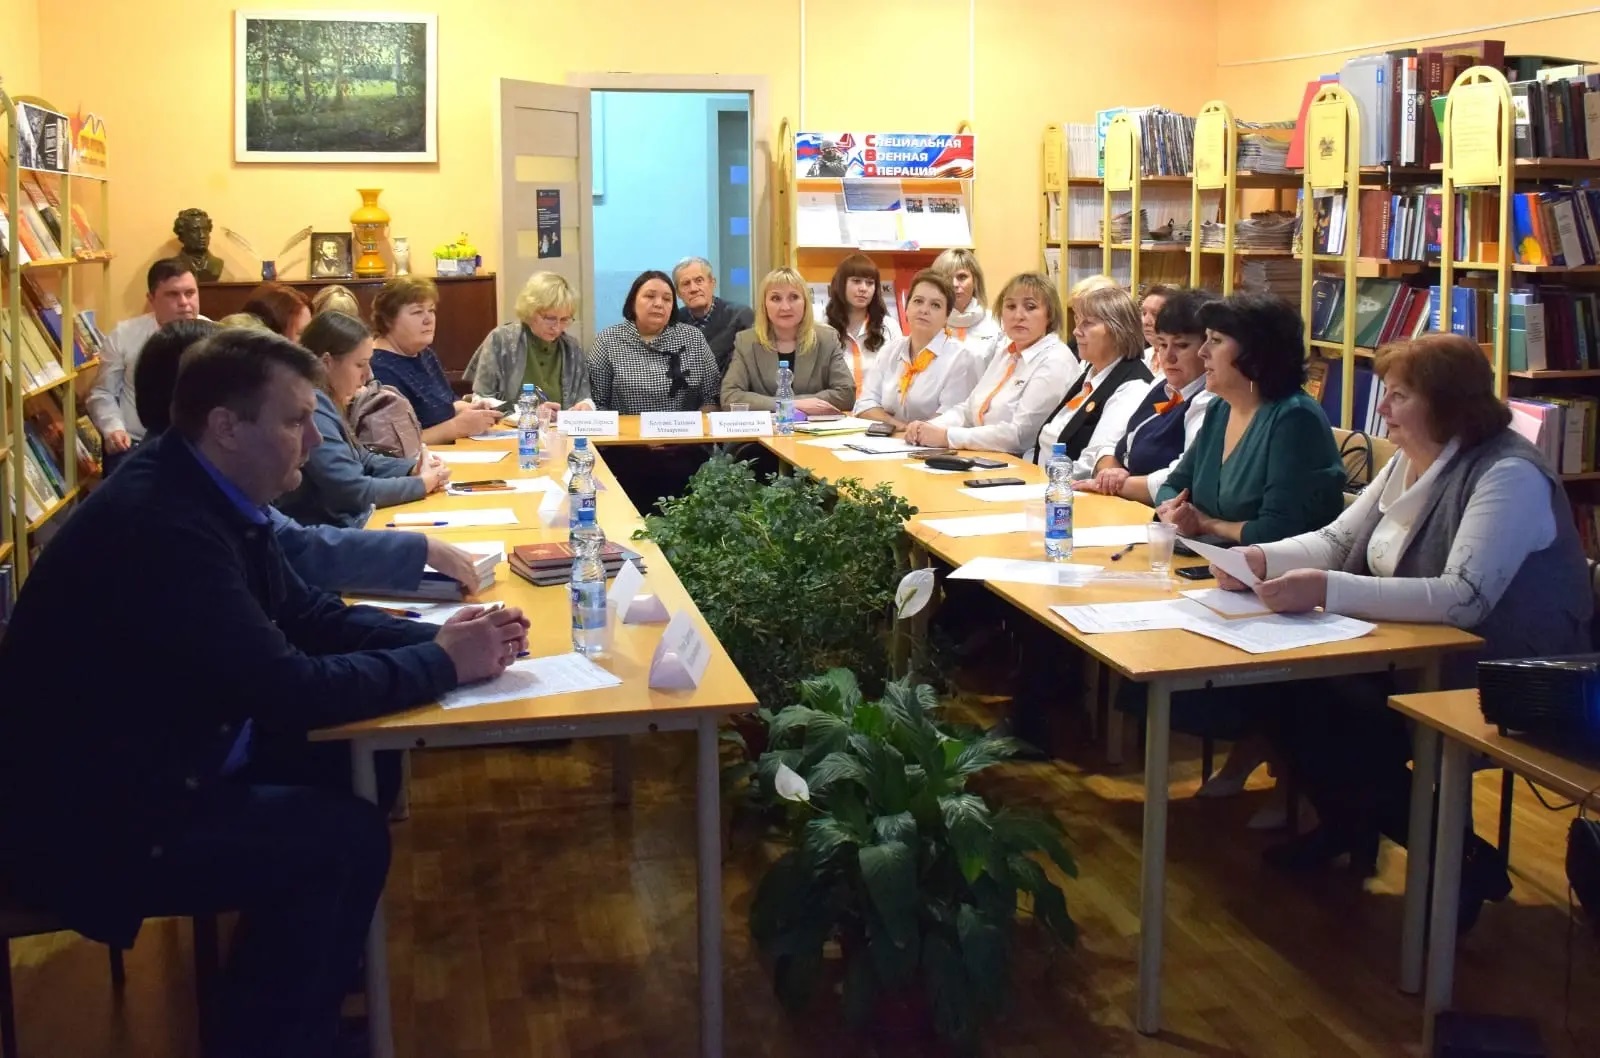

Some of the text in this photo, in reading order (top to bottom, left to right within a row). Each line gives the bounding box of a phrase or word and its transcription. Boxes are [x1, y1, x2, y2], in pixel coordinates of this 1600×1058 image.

[1407, 93, 1416, 122] Food
[865, 134, 961, 148] СПЕЦИАЛЬНАЯ
[865, 149, 928, 162] ВОЕННАЯ
[864, 163, 937, 177] ОПЕРАЦИЯ
